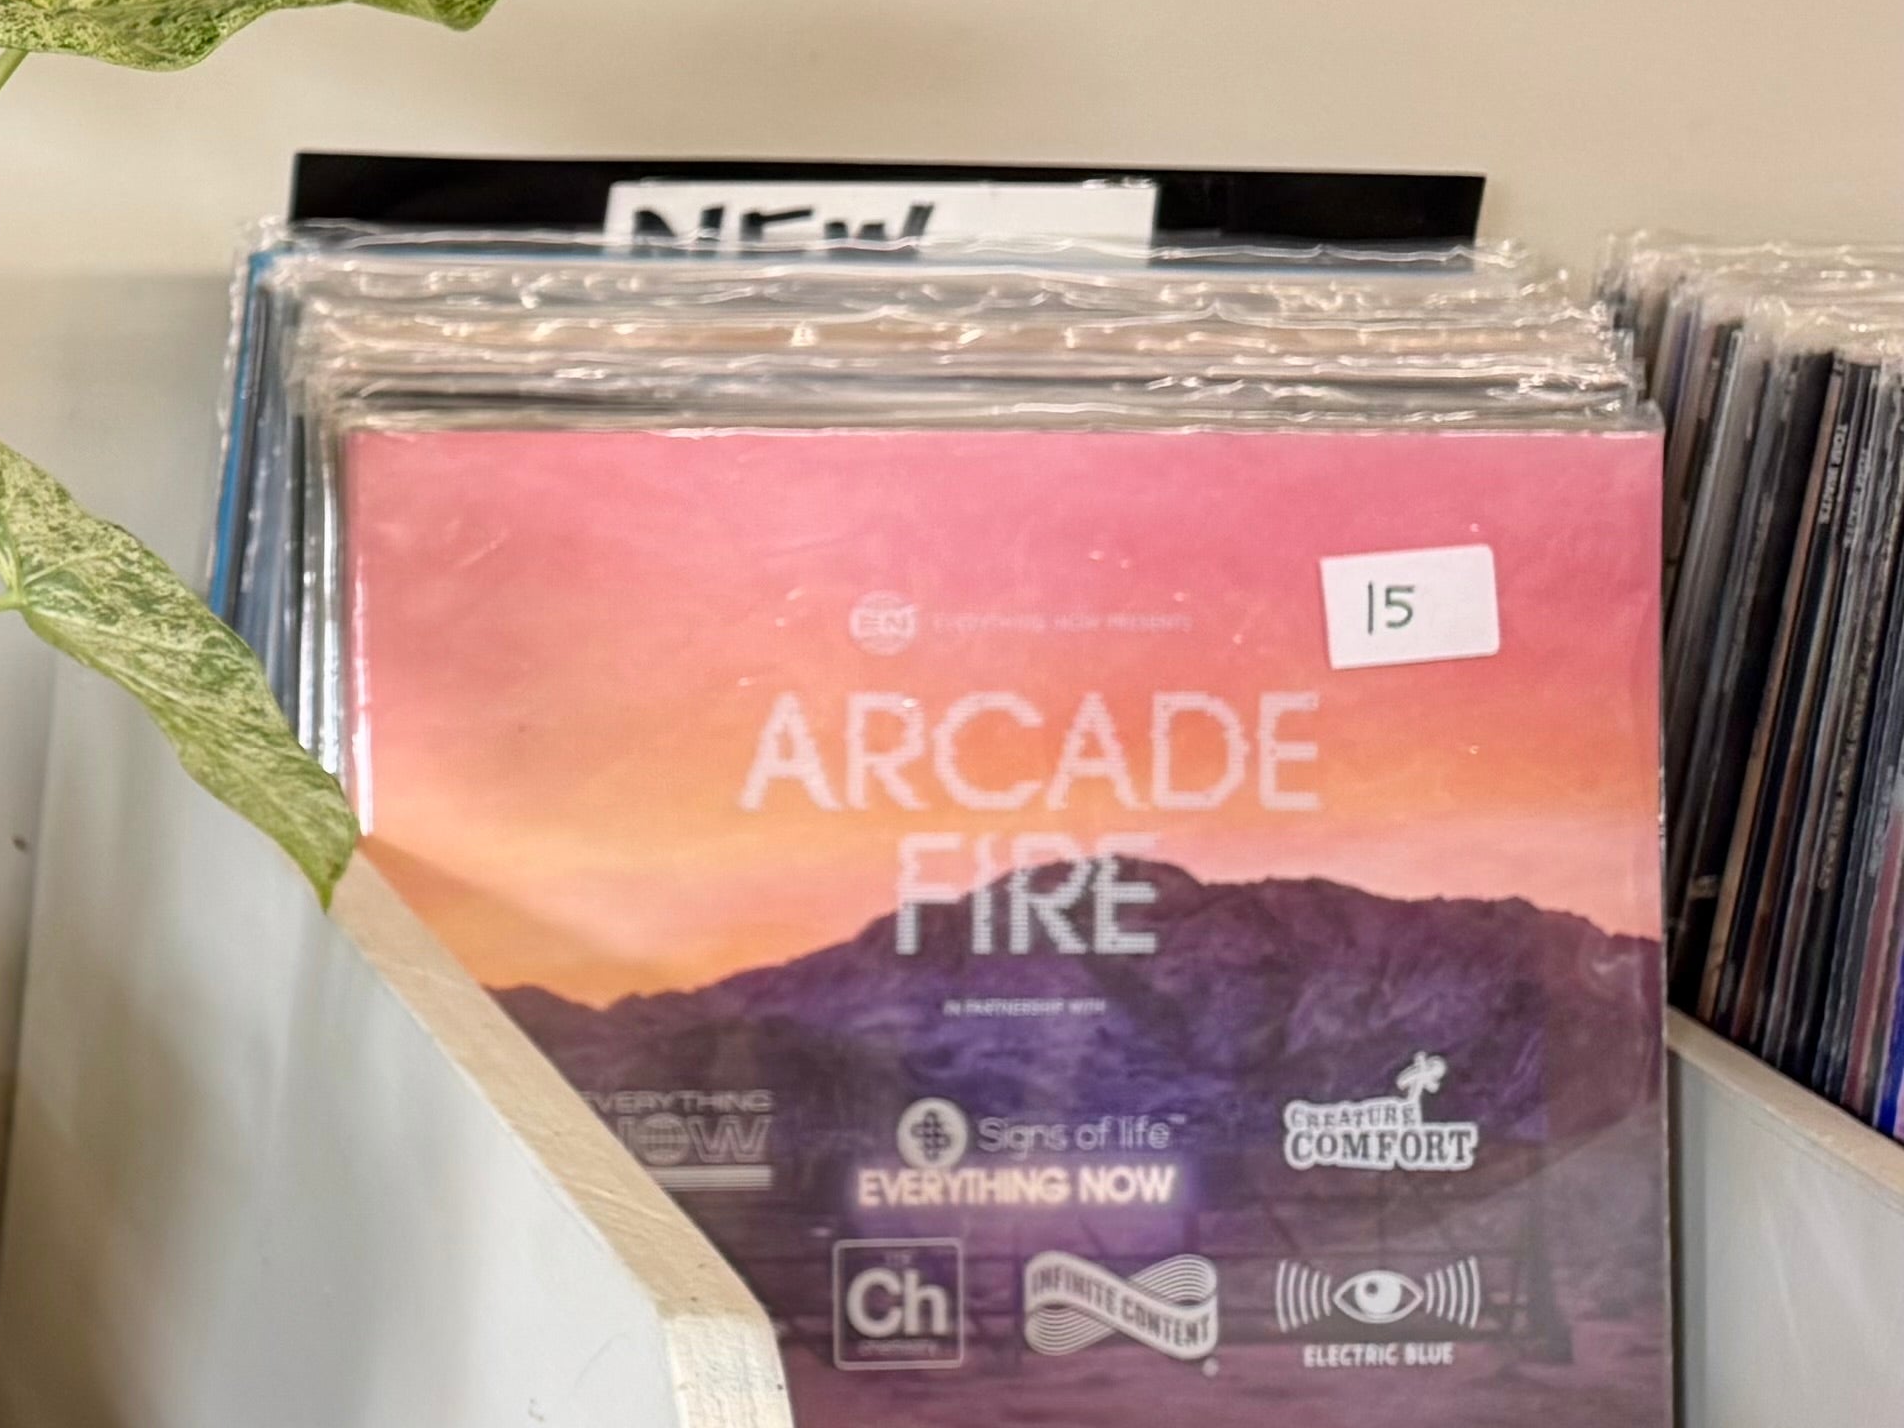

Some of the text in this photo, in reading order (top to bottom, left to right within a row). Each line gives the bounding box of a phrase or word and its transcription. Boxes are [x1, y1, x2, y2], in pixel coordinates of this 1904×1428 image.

[1367, 581, 1415, 636] 15
[738, 689, 1321, 811] ARCADE
[896, 831, 1160, 955] FIRE
[978, 1116, 1068, 1161] Signs
[1075, 1115, 1113, 1151] of
[1291, 1128, 1471, 1163] COMFORT
[858, 1166, 1176, 1206] EVERYTHING NOW
[846, 1266, 948, 1338] Ch
[1303, 1342, 1454, 1367] ELECTRIC BLUE
